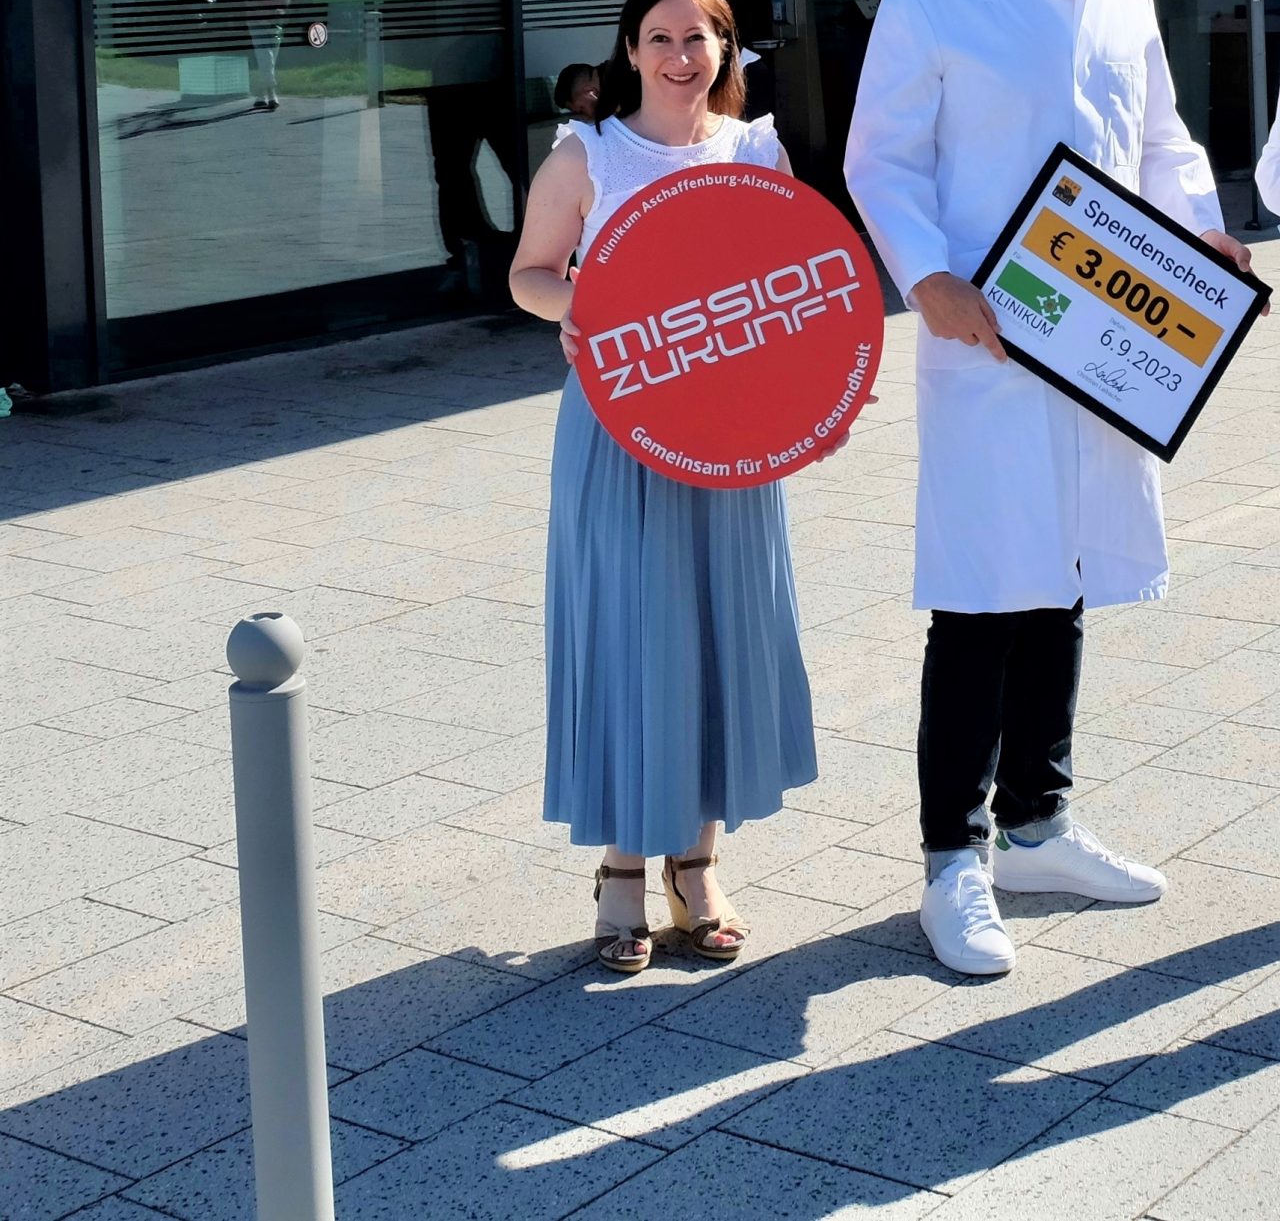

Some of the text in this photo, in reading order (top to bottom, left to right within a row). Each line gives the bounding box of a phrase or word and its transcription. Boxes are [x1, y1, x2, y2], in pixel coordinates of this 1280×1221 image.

[596, 174, 795, 265] Klinikum Aschaffenburg-Alzenau
[1050, 231, 1075, 262] €
[1084, 199, 1230, 310] Spendenscheck
[588, 248, 857, 370] MISSION
[600, 282, 860, 402] ZUKUNFT
[987, 286, 1055, 338] KLINIKUM
[630, 342, 873, 477] Gemeinsam für beste Gesundheit
[1100, 329, 1183, 392] 6.9.2023
